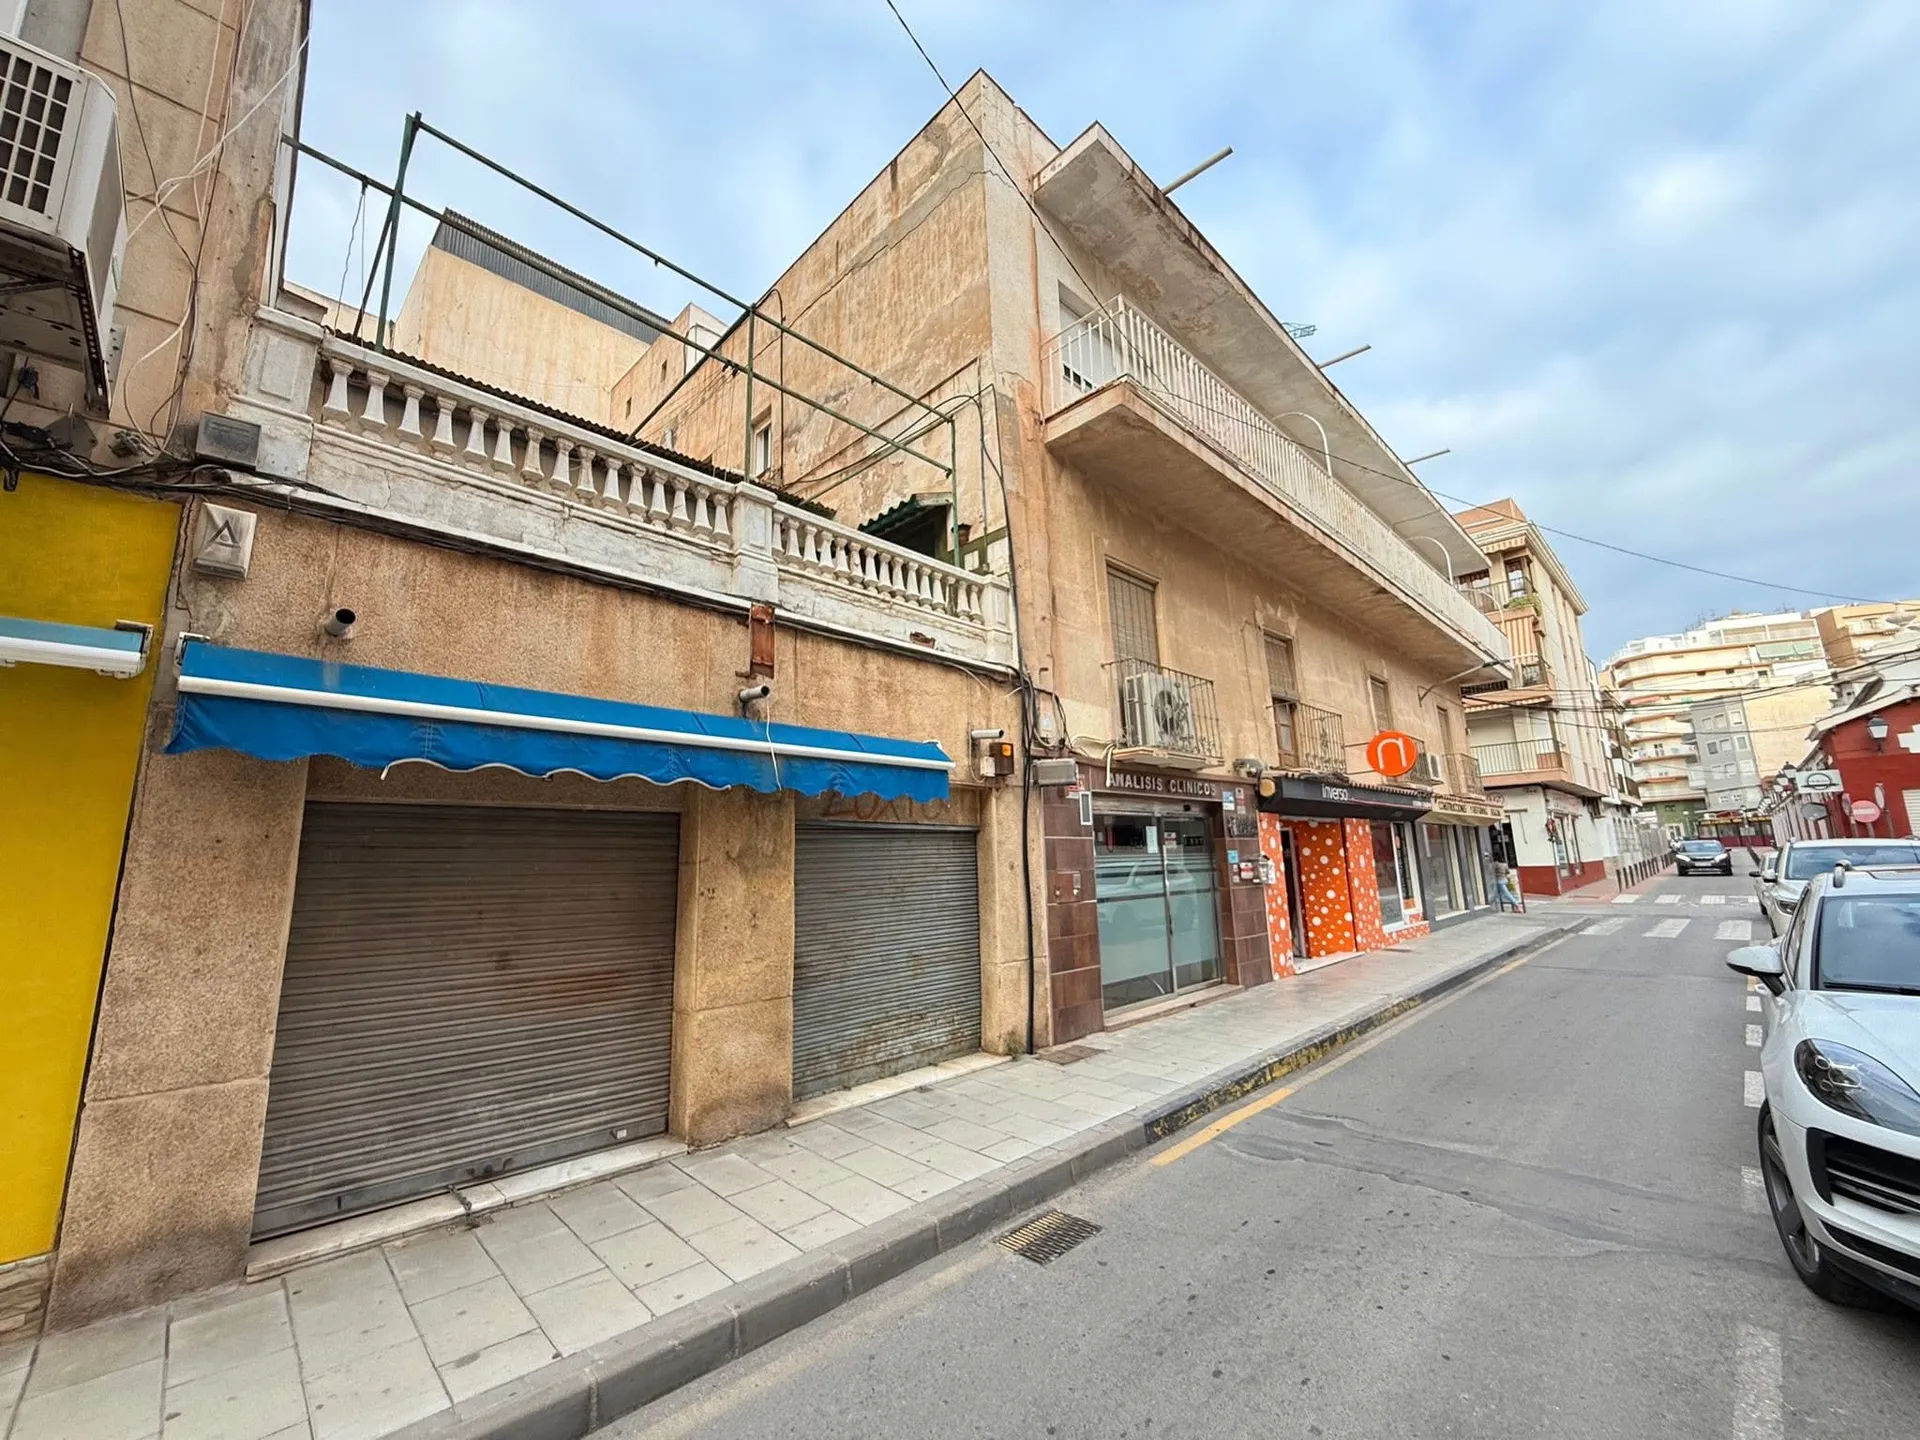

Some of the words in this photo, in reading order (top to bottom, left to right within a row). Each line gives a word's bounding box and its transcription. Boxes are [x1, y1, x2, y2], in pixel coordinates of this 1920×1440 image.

[1109, 772, 1163, 791] ANALISIS
[1169, 779, 1217, 796] CLINICOS
[1322, 783, 1349, 801] inverso
